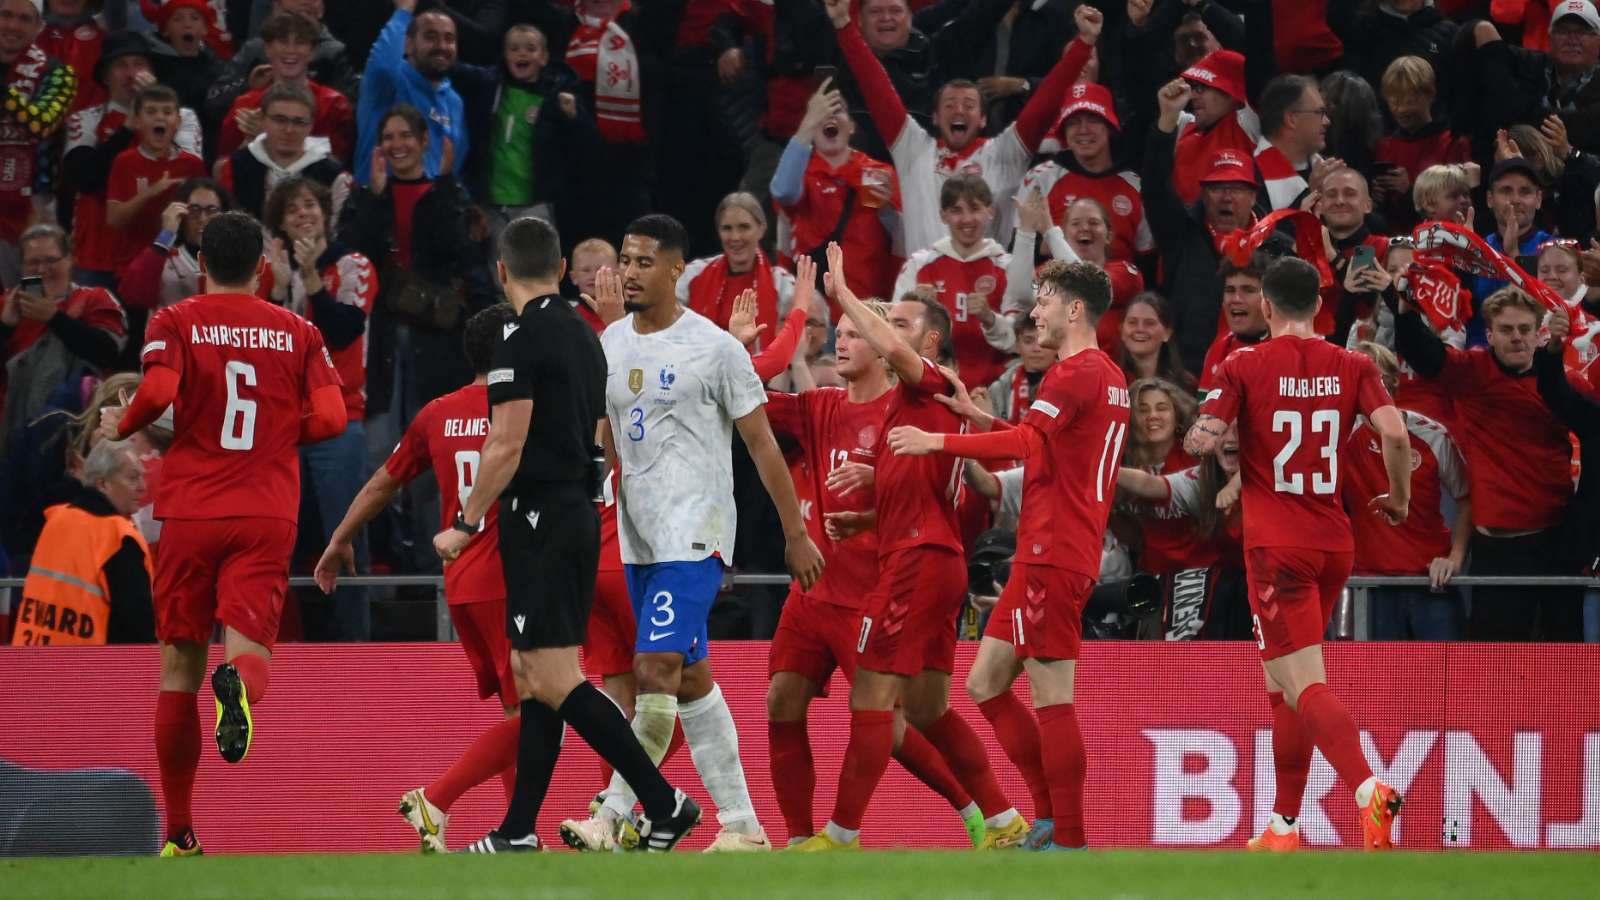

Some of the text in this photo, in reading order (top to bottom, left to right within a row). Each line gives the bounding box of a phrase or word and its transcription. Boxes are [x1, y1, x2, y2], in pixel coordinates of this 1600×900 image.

[505, 115, 514, 143] 1
[956, 293, 967, 322] 9
[192, 325, 293, 352] A.CHRISTENSEN
[1279, 376, 1340, 398] HØJBJERG
[220, 361, 257, 450] 6
[628, 408, 644, 441] 3
[1096, 421, 1126, 502] 11
[1272, 409, 1340, 494] 23
[651, 591, 675, 627] 3
